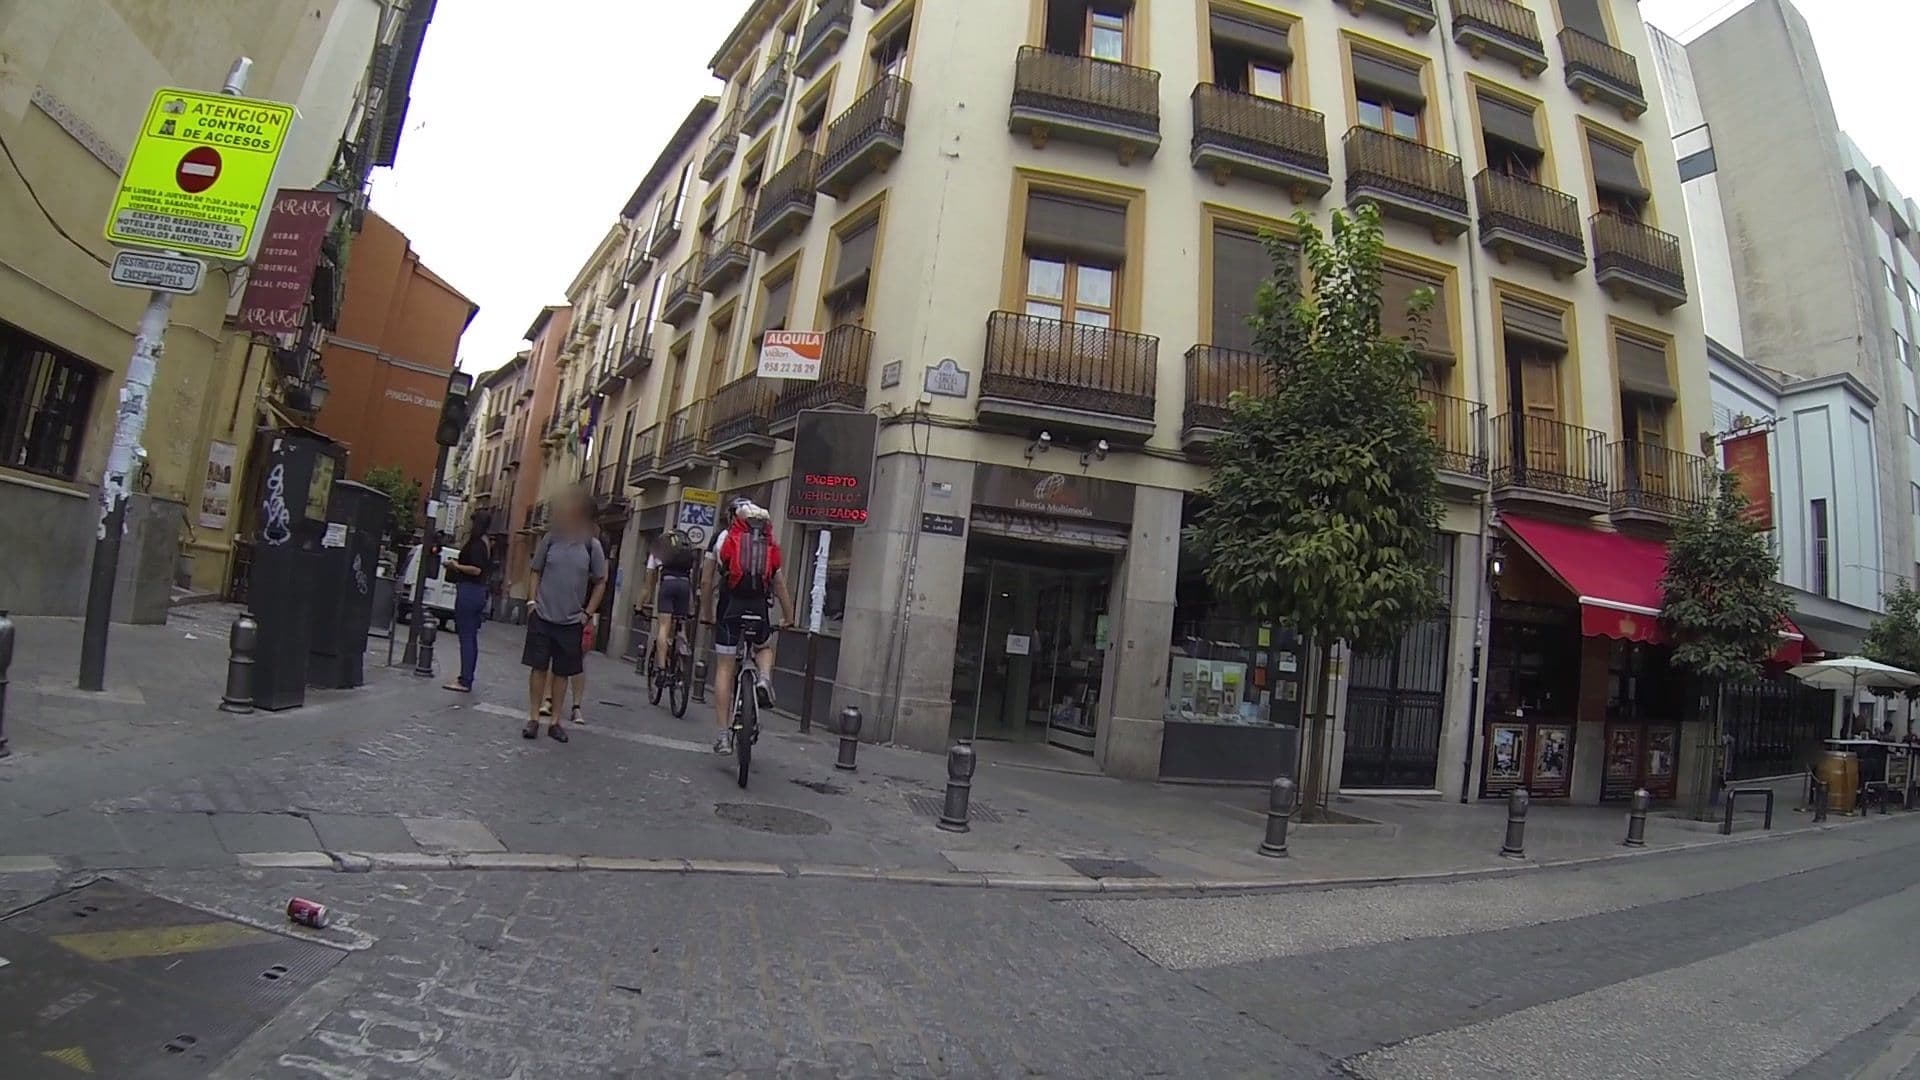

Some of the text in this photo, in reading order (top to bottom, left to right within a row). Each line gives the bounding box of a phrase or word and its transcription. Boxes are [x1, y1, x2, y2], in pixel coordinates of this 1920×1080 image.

[192, 103, 281, 126] ATENCIÓN
[198, 117, 263, 135] CONTROL
[183, 128, 271, 149] DE ACCESOS
[133, 187, 156, 196] LUNES
[164, 191, 192, 200] JUEVES
[160, 205, 170, 213] DE
[170, 207, 206, 218] FESTIVOS
[207, 212, 222, 220] LAS
[223, 214, 233, 222] 24
[201, 203, 237, 215] FESTIVOS
[132, 211, 173, 223] EXCEPTO
[117, 218, 242, 243] HOTELES DEL BARRIO, TAXI Y
[272, 232, 300, 241] KEBAB
[170, 232, 233, 249] AUTORIZADOS
[120, 256, 197, 275] RESTRICTED ACCESS
[258, 263, 298, 273] ORIENTAL
[251, 279, 301, 290] ALAL FOOD
[767, 333, 820, 346] ALQUILA
[805, 474, 857, 488] EXCEPTO
[788, 505, 868, 520] AUTORIZADOS
[1047, 503, 1093, 517] Multimedia
